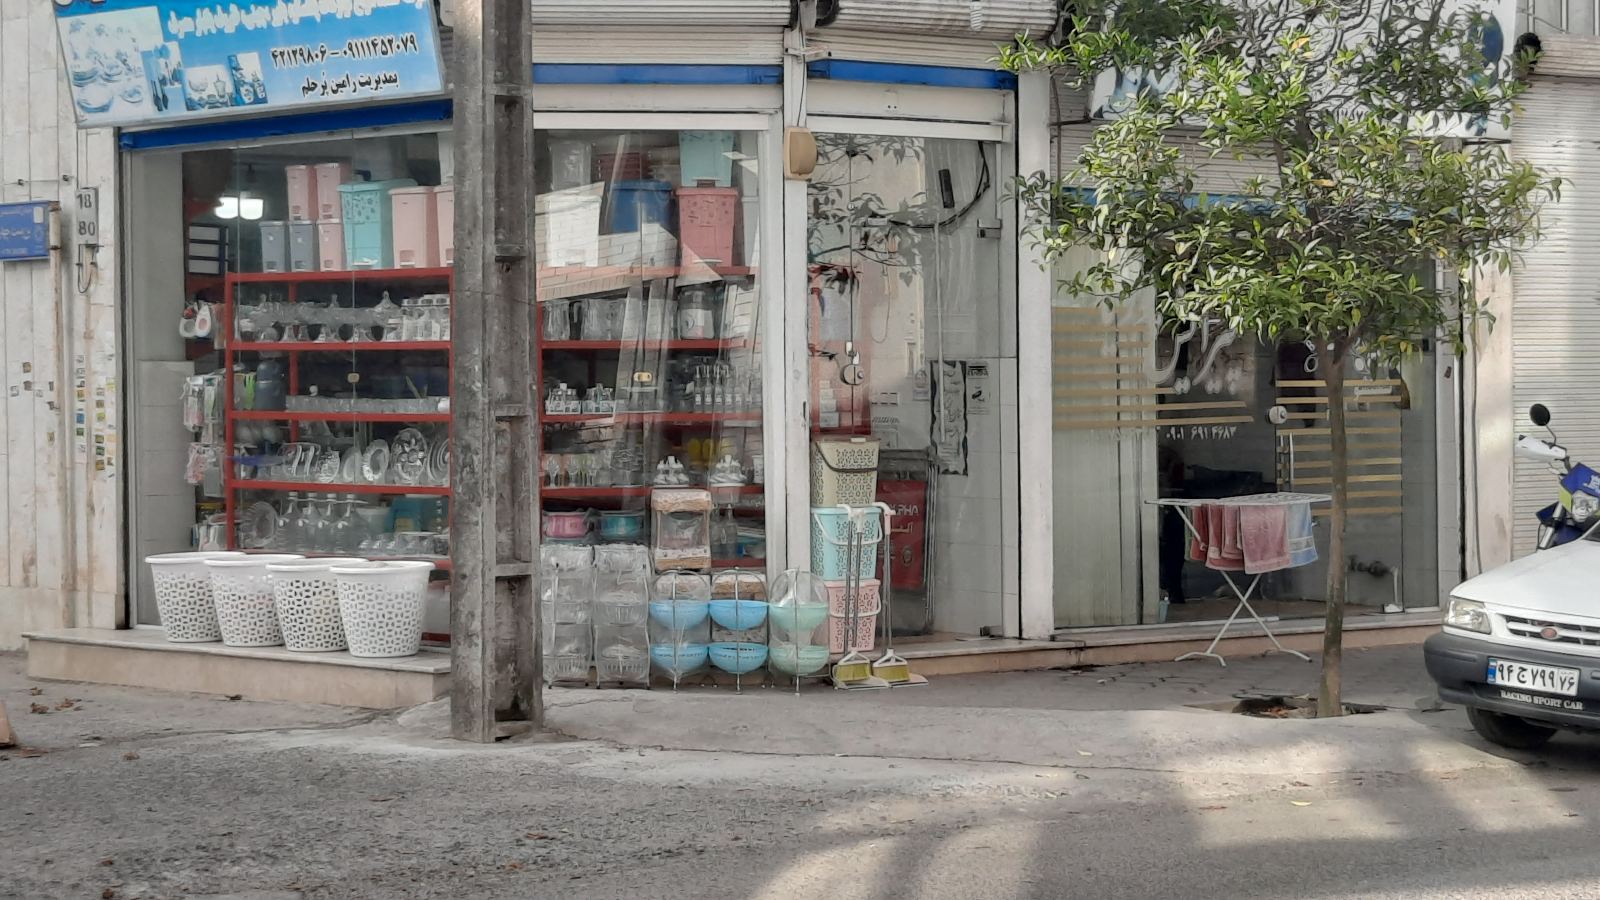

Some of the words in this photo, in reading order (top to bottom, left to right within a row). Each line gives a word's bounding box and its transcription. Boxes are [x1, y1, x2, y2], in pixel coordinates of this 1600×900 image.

[331, 73, 357, 95] رامین
[77, 193, 92, 209] 18
[78, 220, 96, 236] 80
[1501, 690, 1532, 703] RACING
[1533, 696, 1562, 707] SPORT
[1563, 700, 1583, 710] CAR
